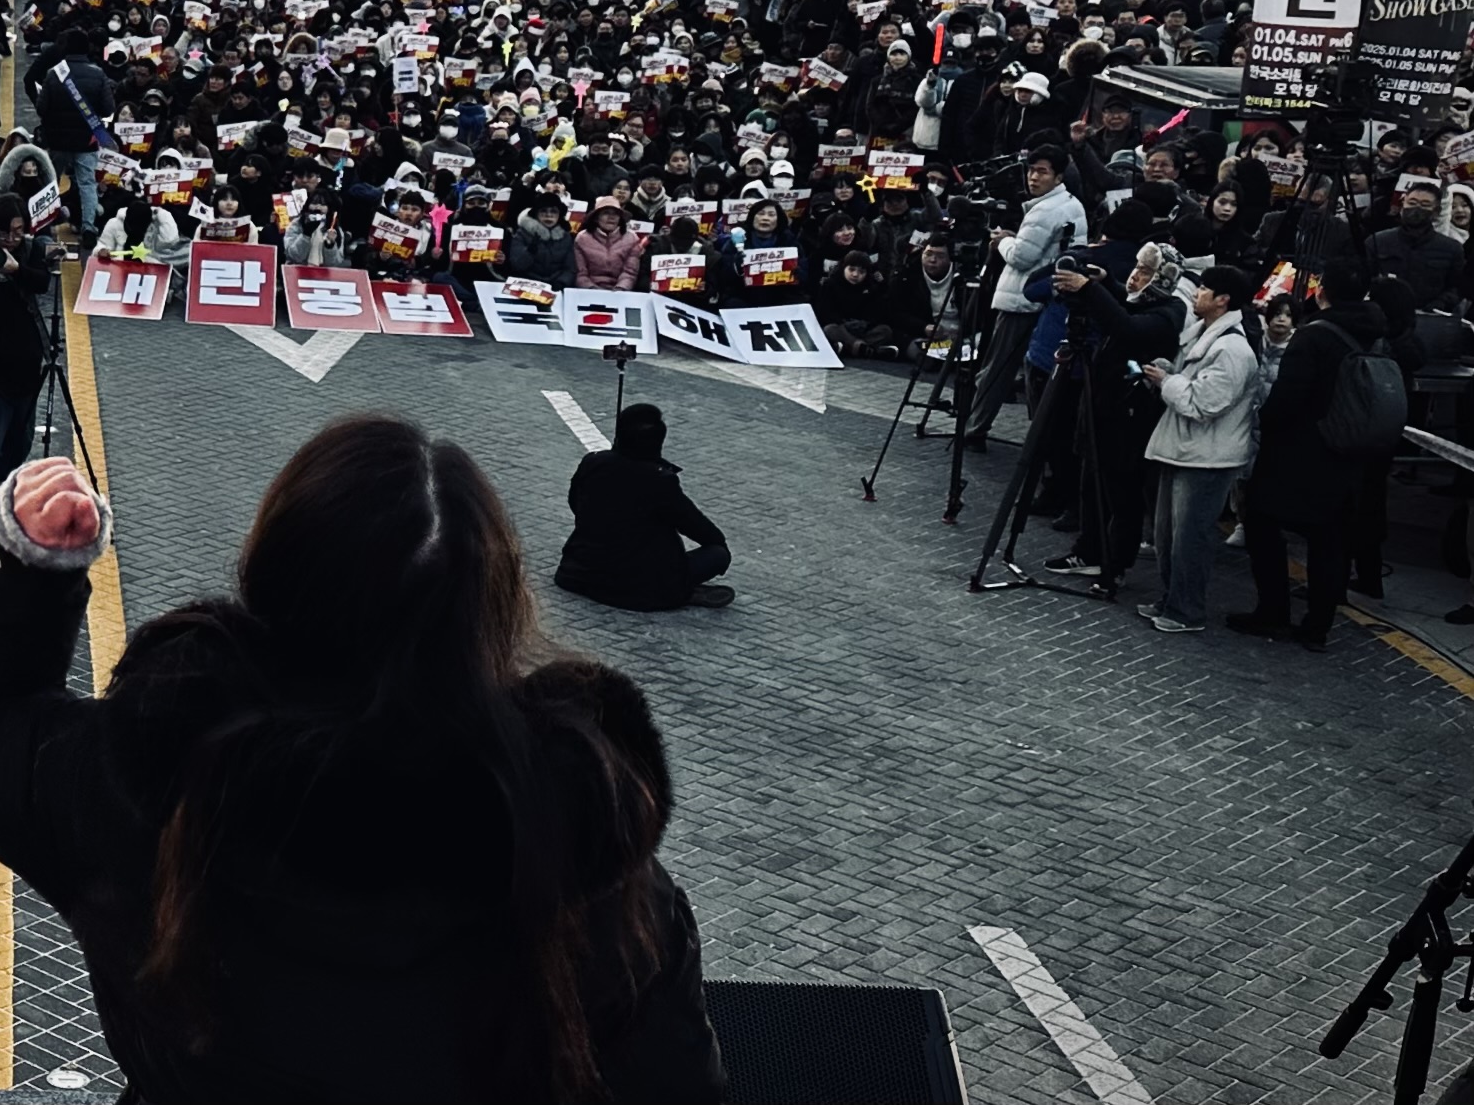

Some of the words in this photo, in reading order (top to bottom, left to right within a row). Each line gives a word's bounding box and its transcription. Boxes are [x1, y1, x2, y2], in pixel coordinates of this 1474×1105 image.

[1360, 42, 1417, 59] 2025.01.04
[1417, 48, 1439, 60] SAT
[1414, 61, 1438, 74] SUN
[750, 250, 785, 262] 내란수괴
[657, 257, 693, 268] 내란수괴
